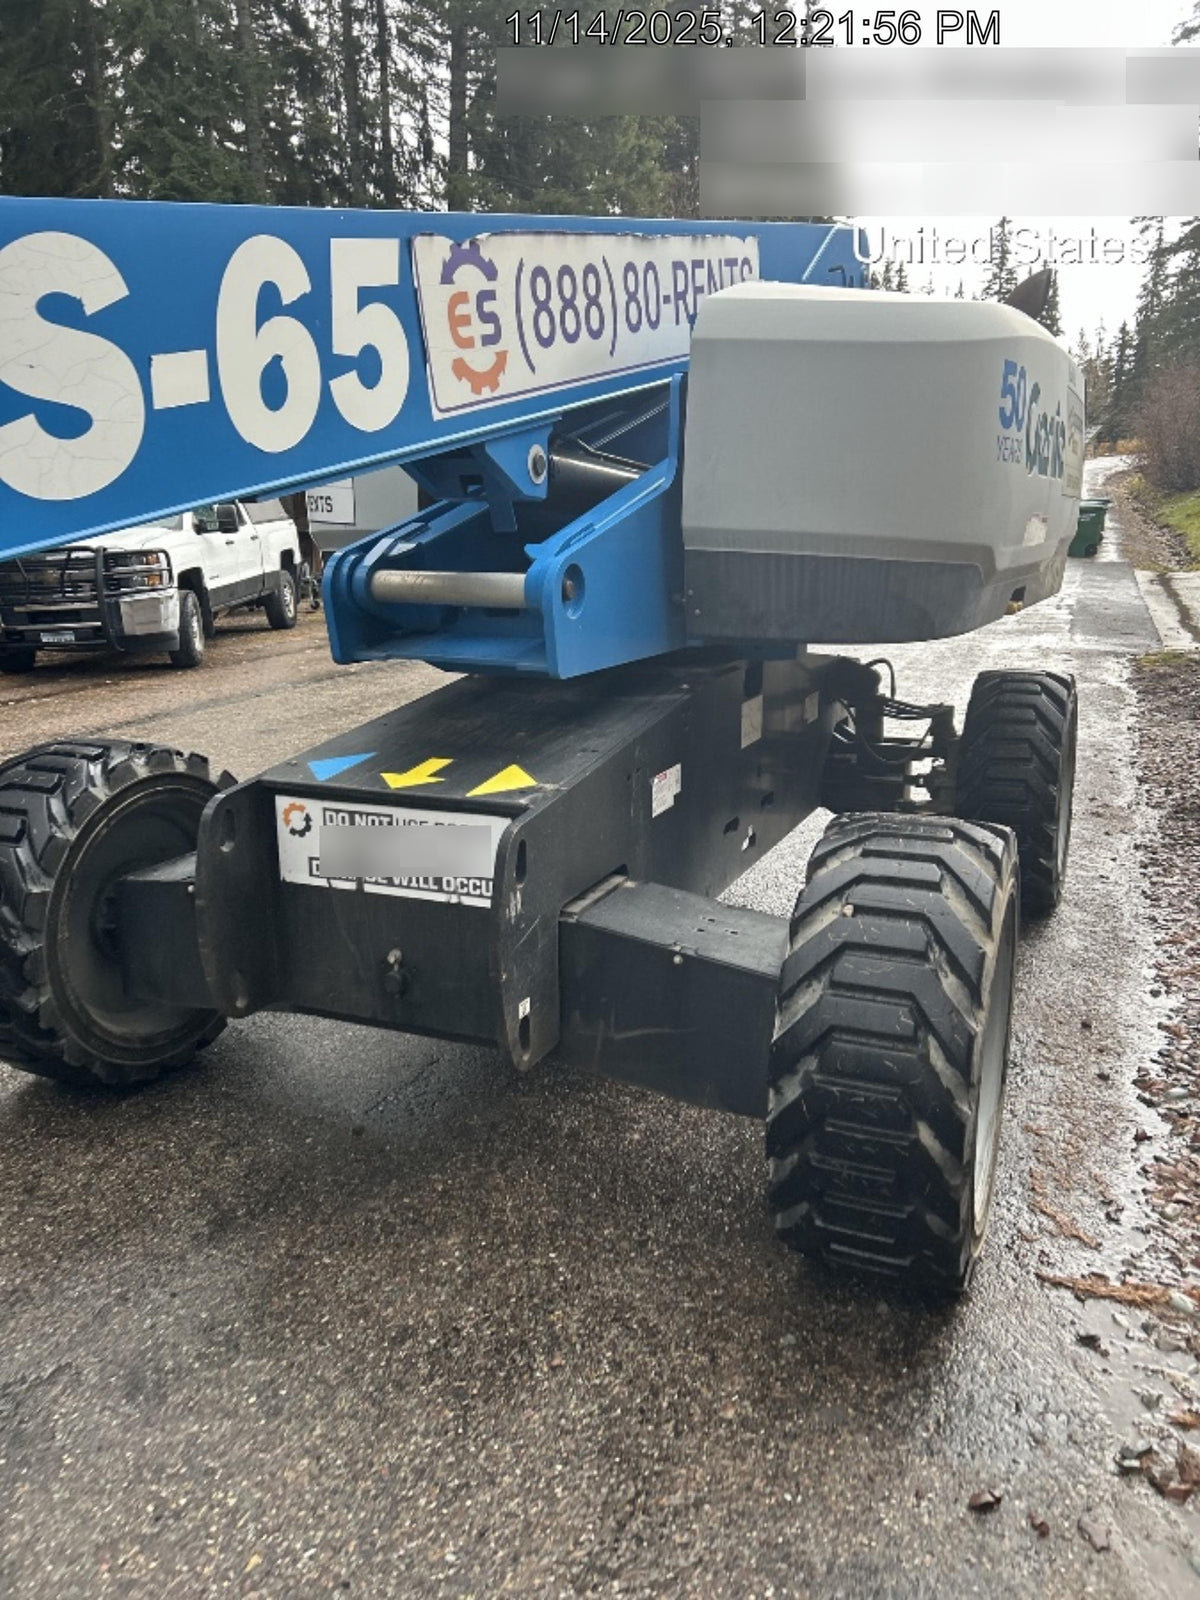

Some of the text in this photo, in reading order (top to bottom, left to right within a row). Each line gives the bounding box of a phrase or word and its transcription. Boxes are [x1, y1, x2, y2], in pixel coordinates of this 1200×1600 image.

[515, 255, 618, 375] (888)
[0, 230, 410, 500] S-65
[998, 359, 1027, 432] 50
[325, 810, 350, 827] DO
[354, 813, 392, 827] NOT
[392, 875, 440, 890] WILL
